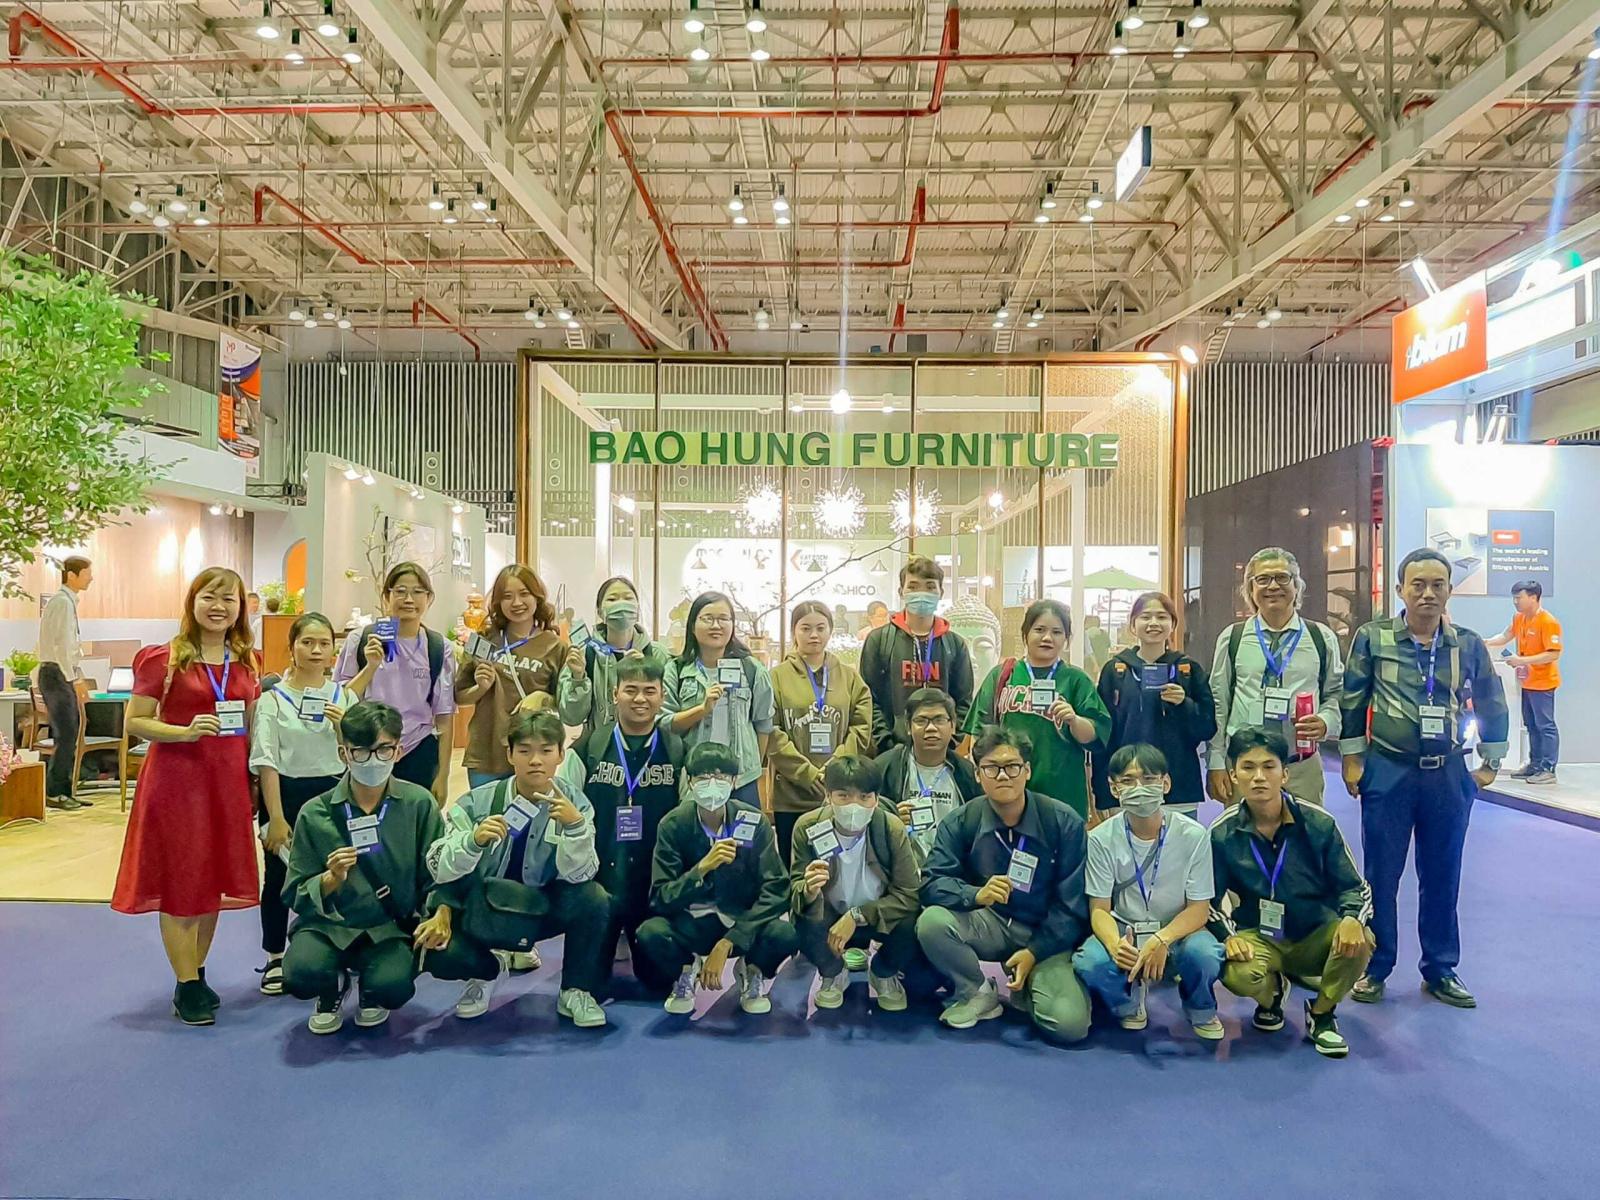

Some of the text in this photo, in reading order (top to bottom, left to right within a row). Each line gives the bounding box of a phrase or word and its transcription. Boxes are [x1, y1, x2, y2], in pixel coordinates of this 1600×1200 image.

[589, 431, 1120, 467] BAO HUNG FURNITURE
[909, 790, 952, 800] SPEMAN
